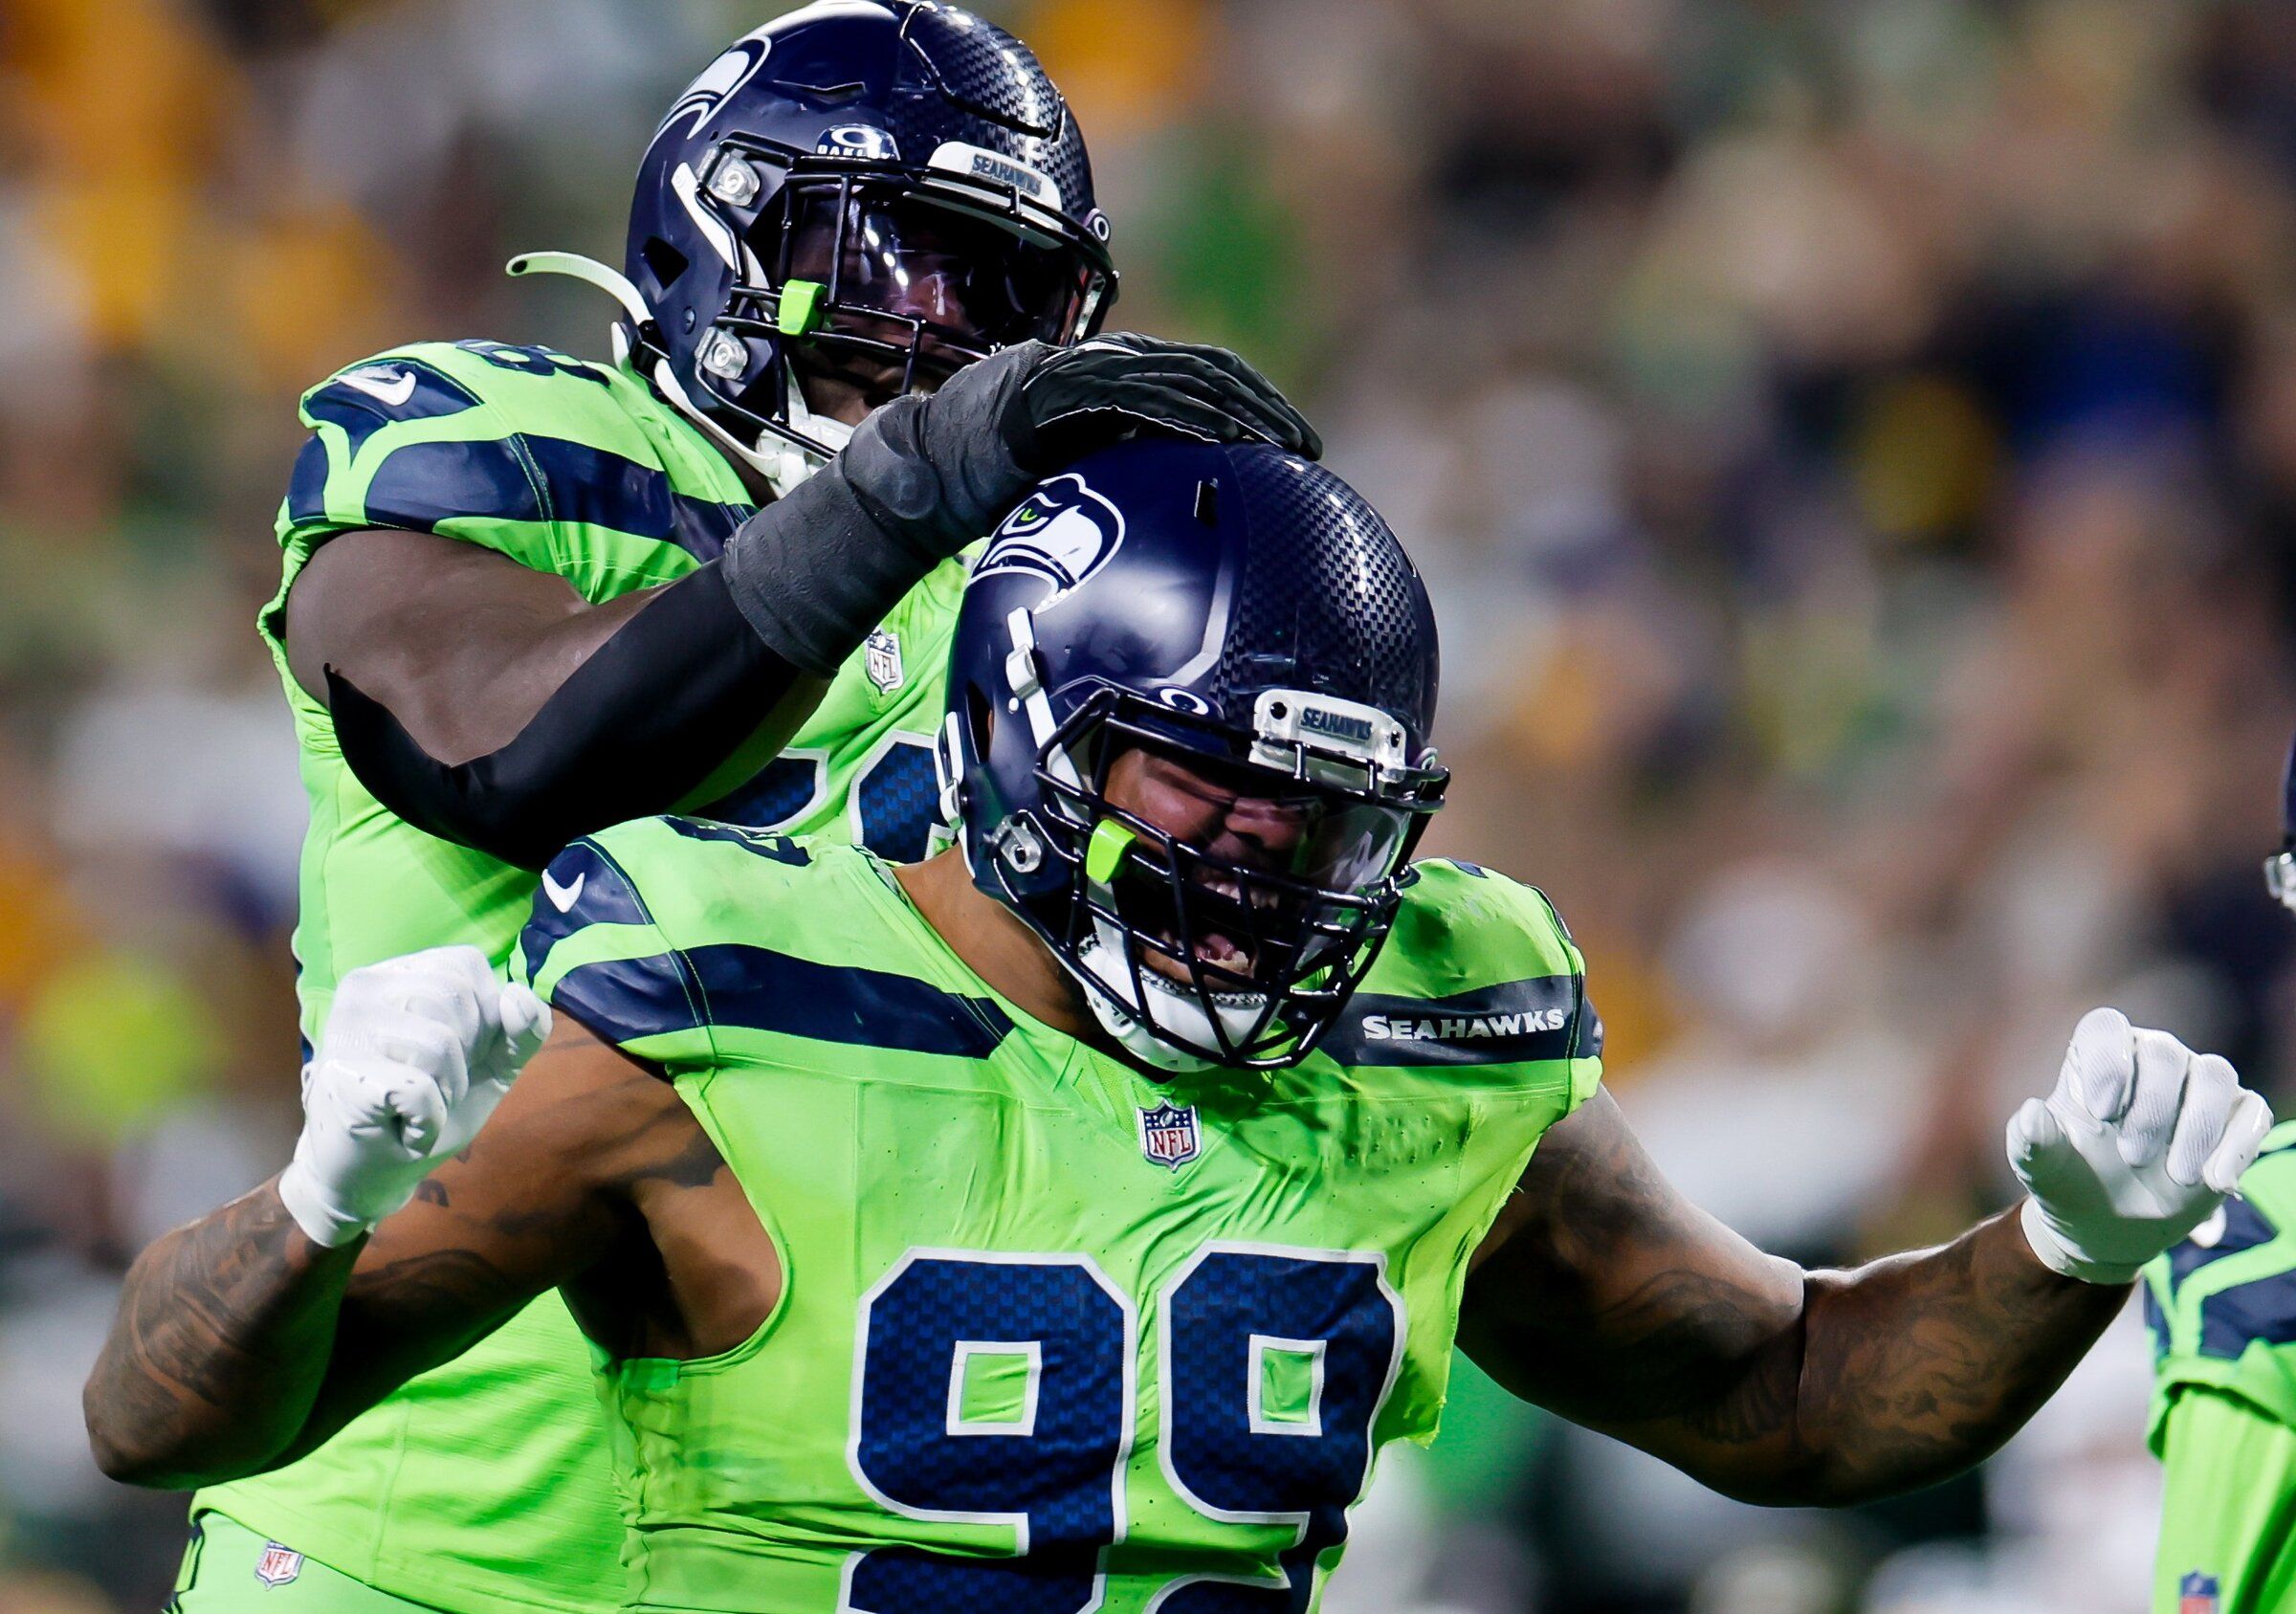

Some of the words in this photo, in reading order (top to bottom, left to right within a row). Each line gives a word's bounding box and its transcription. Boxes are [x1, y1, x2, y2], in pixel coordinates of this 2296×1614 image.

[817, 144, 891, 160] OAKLY
[870, 651, 897, 681] NFL
[1362, 1008, 1565, 1040] SEAHAWKS
[1151, 1129, 1191, 1157] NFL
[836, 1240, 1406, 1614] 99
[260, 1550, 292, 1577] NFL
